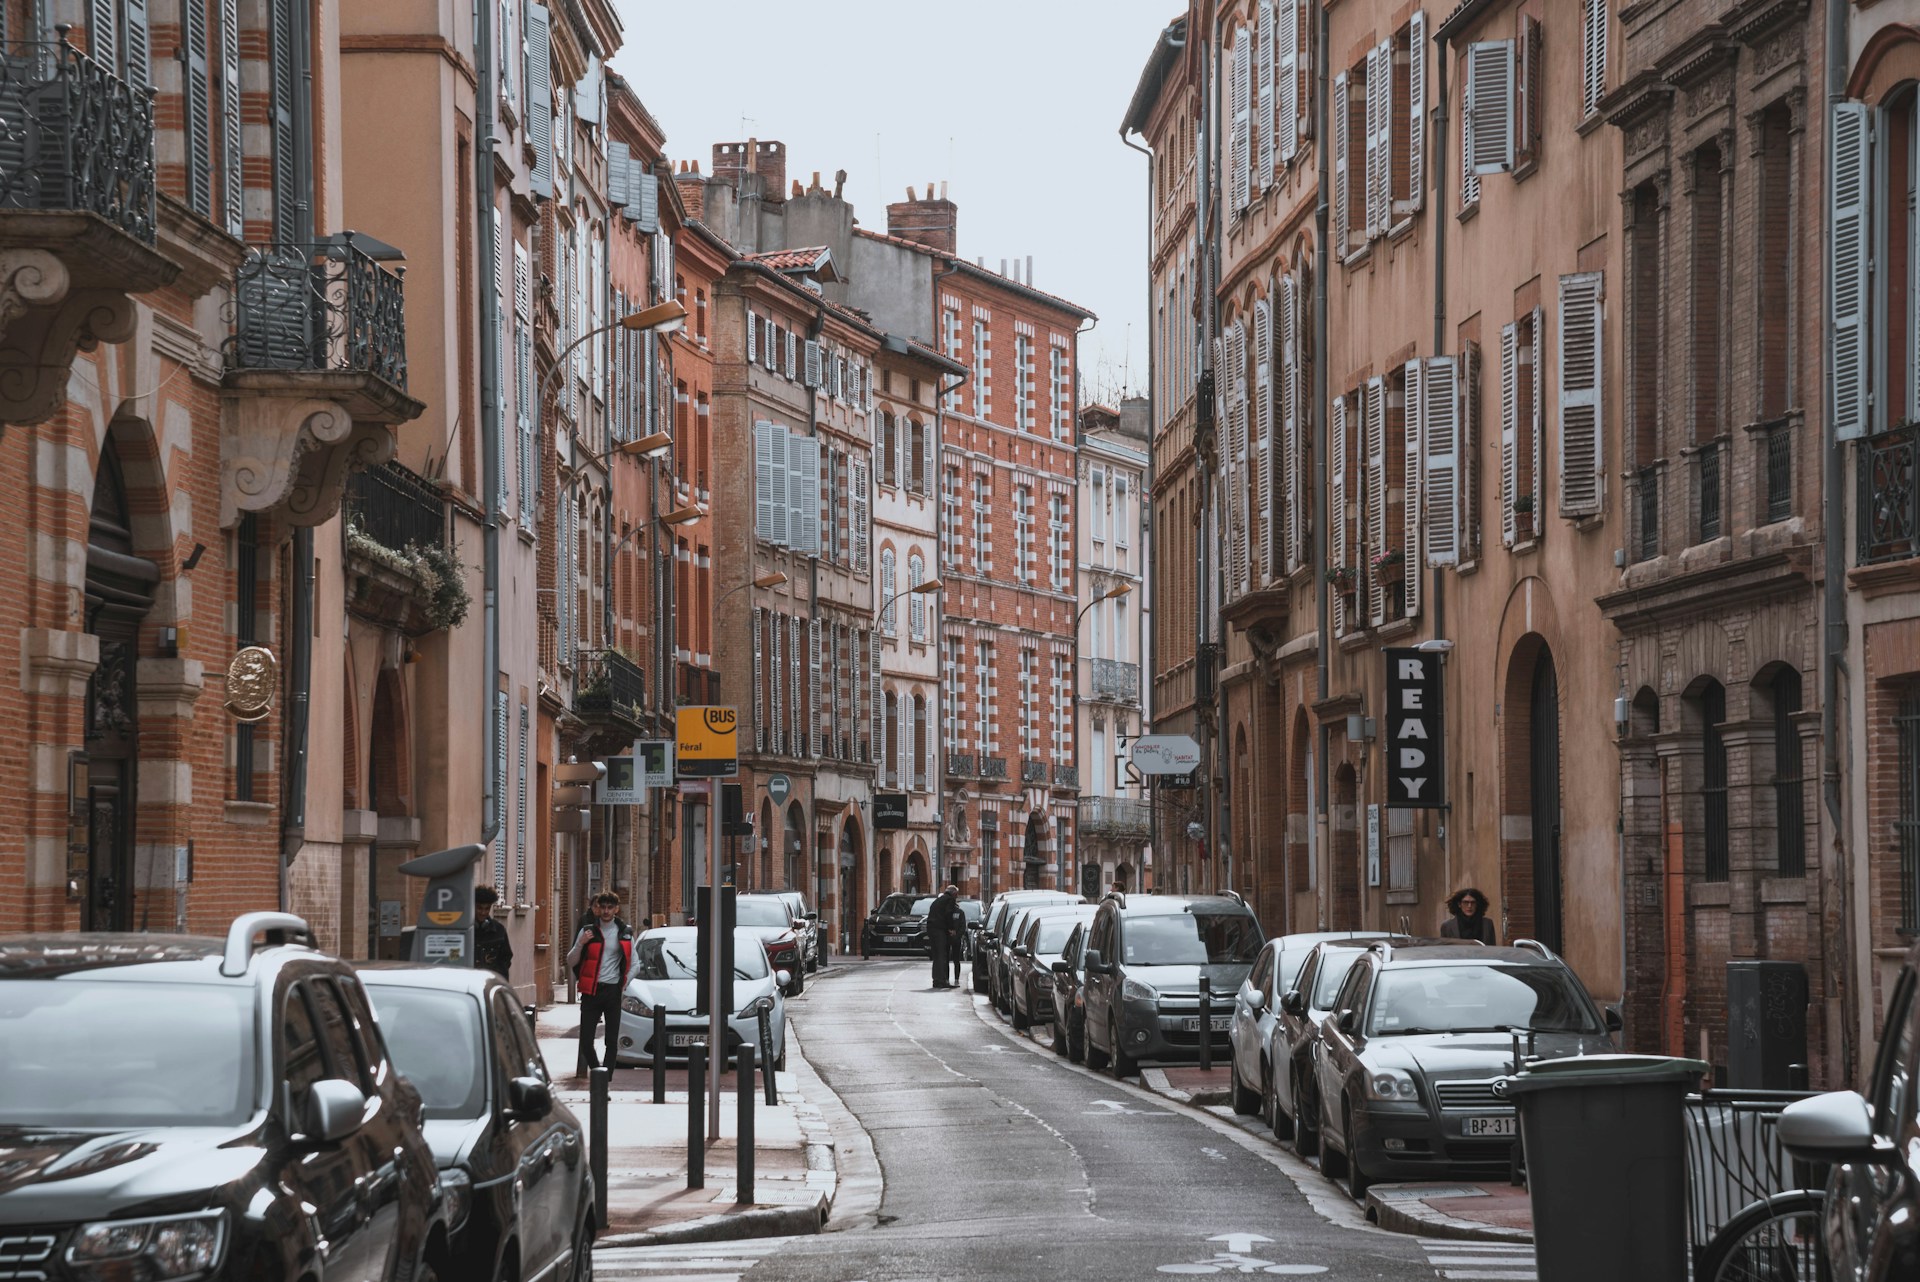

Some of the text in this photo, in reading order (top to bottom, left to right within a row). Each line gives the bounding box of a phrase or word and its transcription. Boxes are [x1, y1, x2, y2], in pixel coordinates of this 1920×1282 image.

[710, 710, 735, 723] BUS
[1397, 659, 1428, 798] READY
[680, 743, 702, 751] Féral
[437, 888, 453, 910] P
[1472, 1119, 1516, 1133] BP-31
